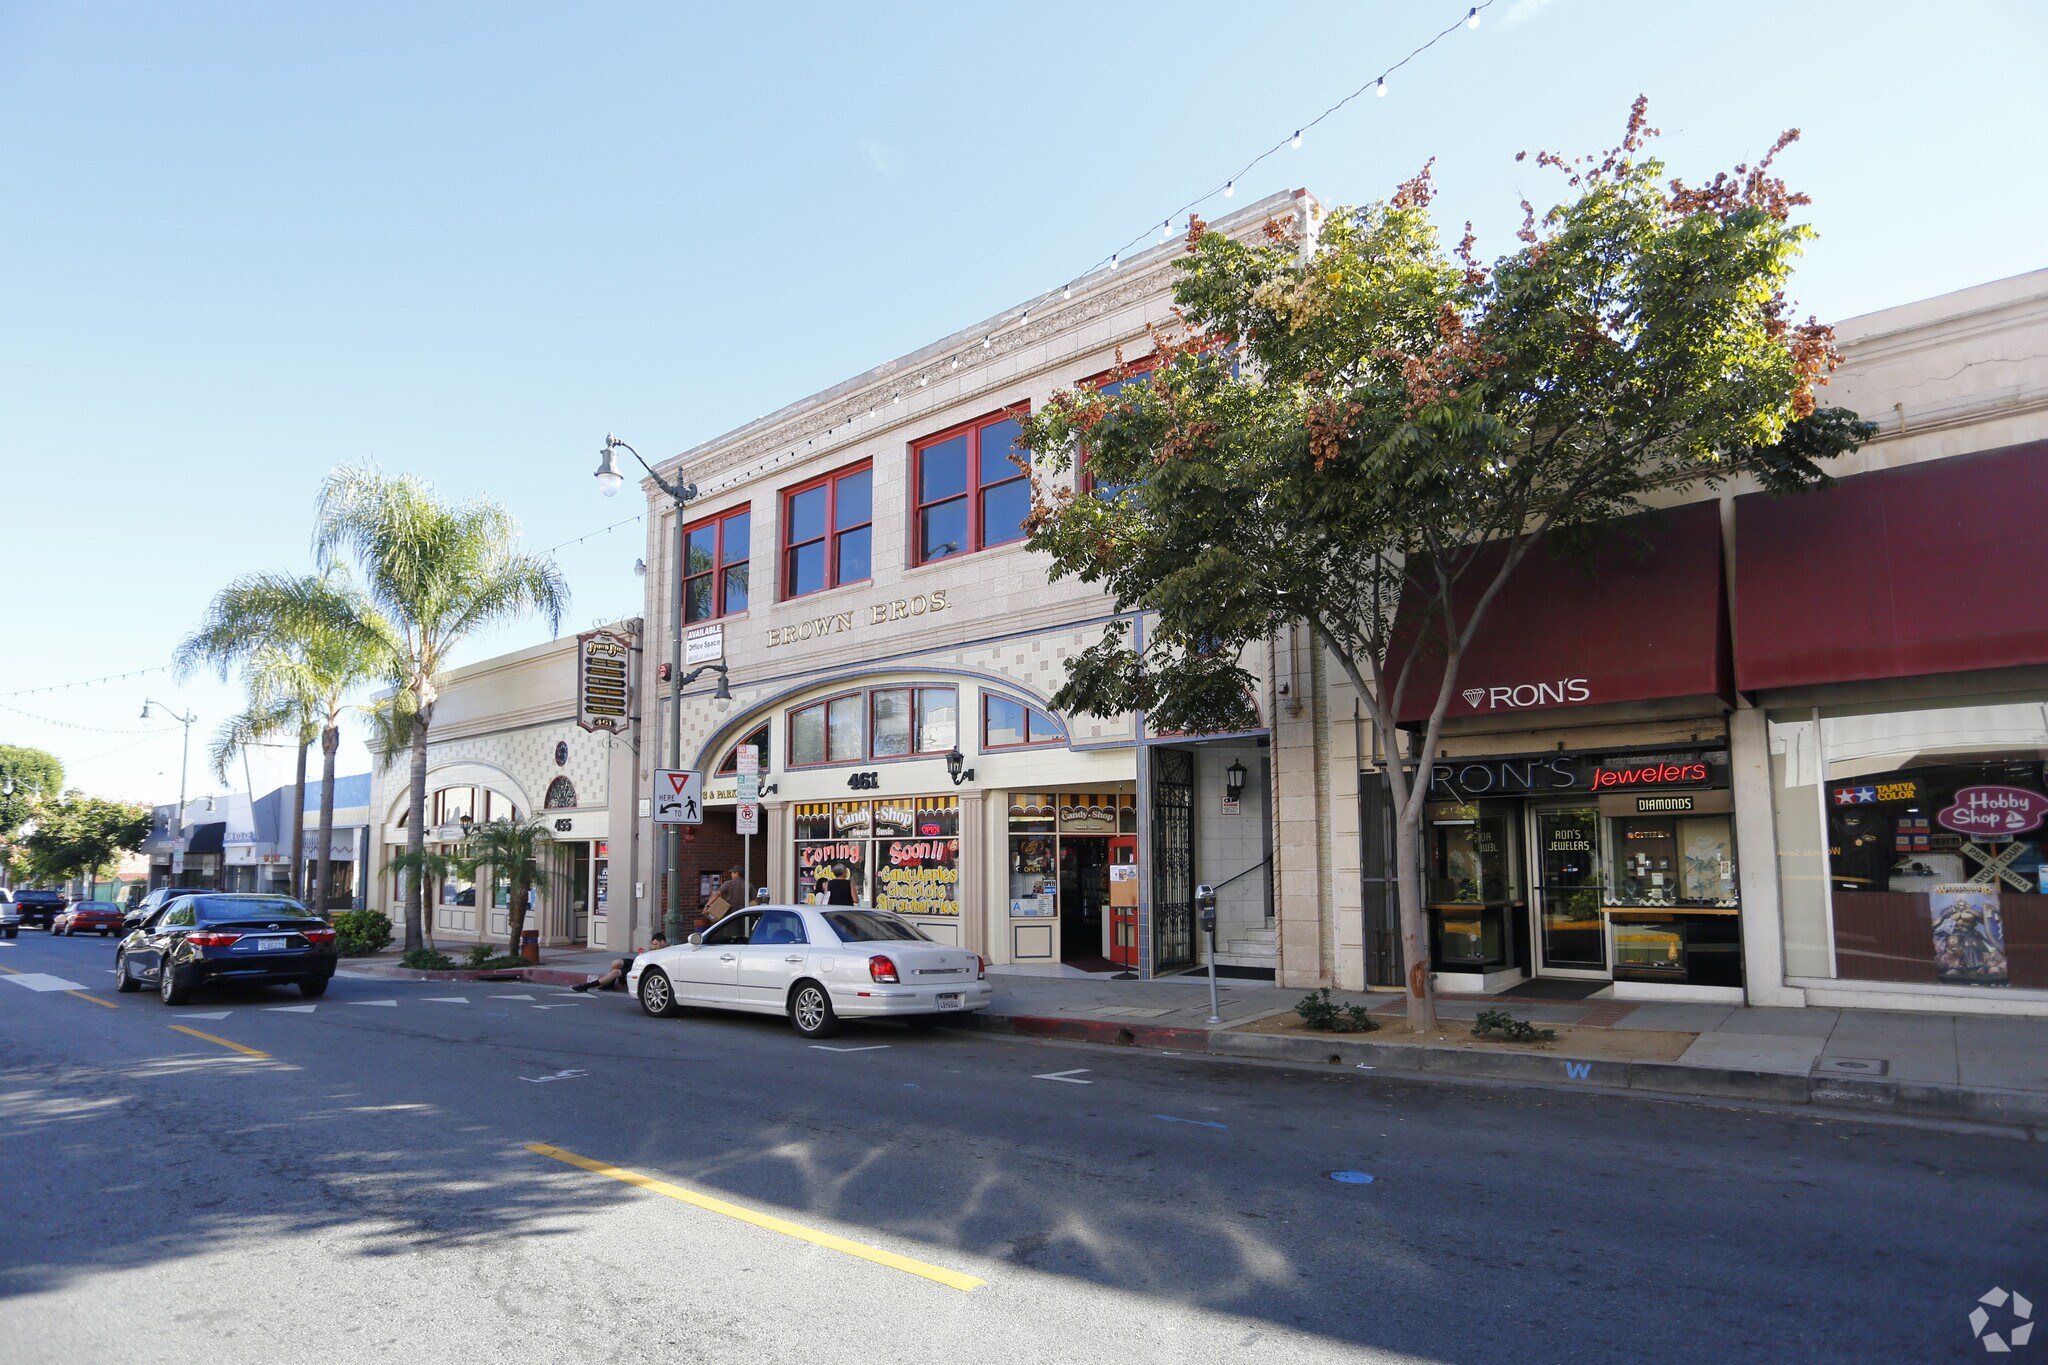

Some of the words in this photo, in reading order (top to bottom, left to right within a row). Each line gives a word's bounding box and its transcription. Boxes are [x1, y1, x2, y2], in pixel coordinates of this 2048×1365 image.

[766, 610, 853, 648] BROWN
[870, 590, 951, 625] BROS.
[688, 624, 722, 639] AVAILABLE
[689, 643, 703, 651] Office
[704, 640, 720, 649] Space
[1489, 678, 1590, 708] RON'S
[738, 775, 744, 783] 2
[847, 771, 879, 790] 461
[1431, 758, 1575, 804] RON'S
[709, 791, 715, 800] &
[717, 790, 737, 799] PARK
[1875, 782, 1916, 793] TAMIYA
[1877, 791, 1915, 800] COLOR
[1639, 798, 1692, 810] DIAMONDS
[1968, 792, 2029, 811] Hobby
[835, 807, 870, 828] Candy
[880, 807, 912, 827] Shop
[1061, 810, 1088, 821] Candy
[1092, 810, 1114, 822] Shop
[1952, 808, 2000, 828] Shop
[554, 818, 571, 831] 455
[852, 828, 870, 836] Sweet
[876, 828, 894, 836] Susie
[921, 825, 940, 835] OPEN
[1555, 828, 1581, 840] RON'S
[1548, 841, 1590, 851] JEWELERS
[2000, 844, 2023, 863] TOUR
[803, 843, 860, 866] Coming
[1968, 847, 1988, 862] PSR
[881, 866, 915, 884] Candy
[914, 865, 958, 884] Apples
[1974, 863, 2000, 884] AYOUT
[2001, 869, 2028, 890] NMRA
[887, 882, 947, 899] Chocolate
[876, 894, 959, 914] Strawberries
[1013, 902, 1020, 910] A
[1566, 1061, 1591, 1079] W
